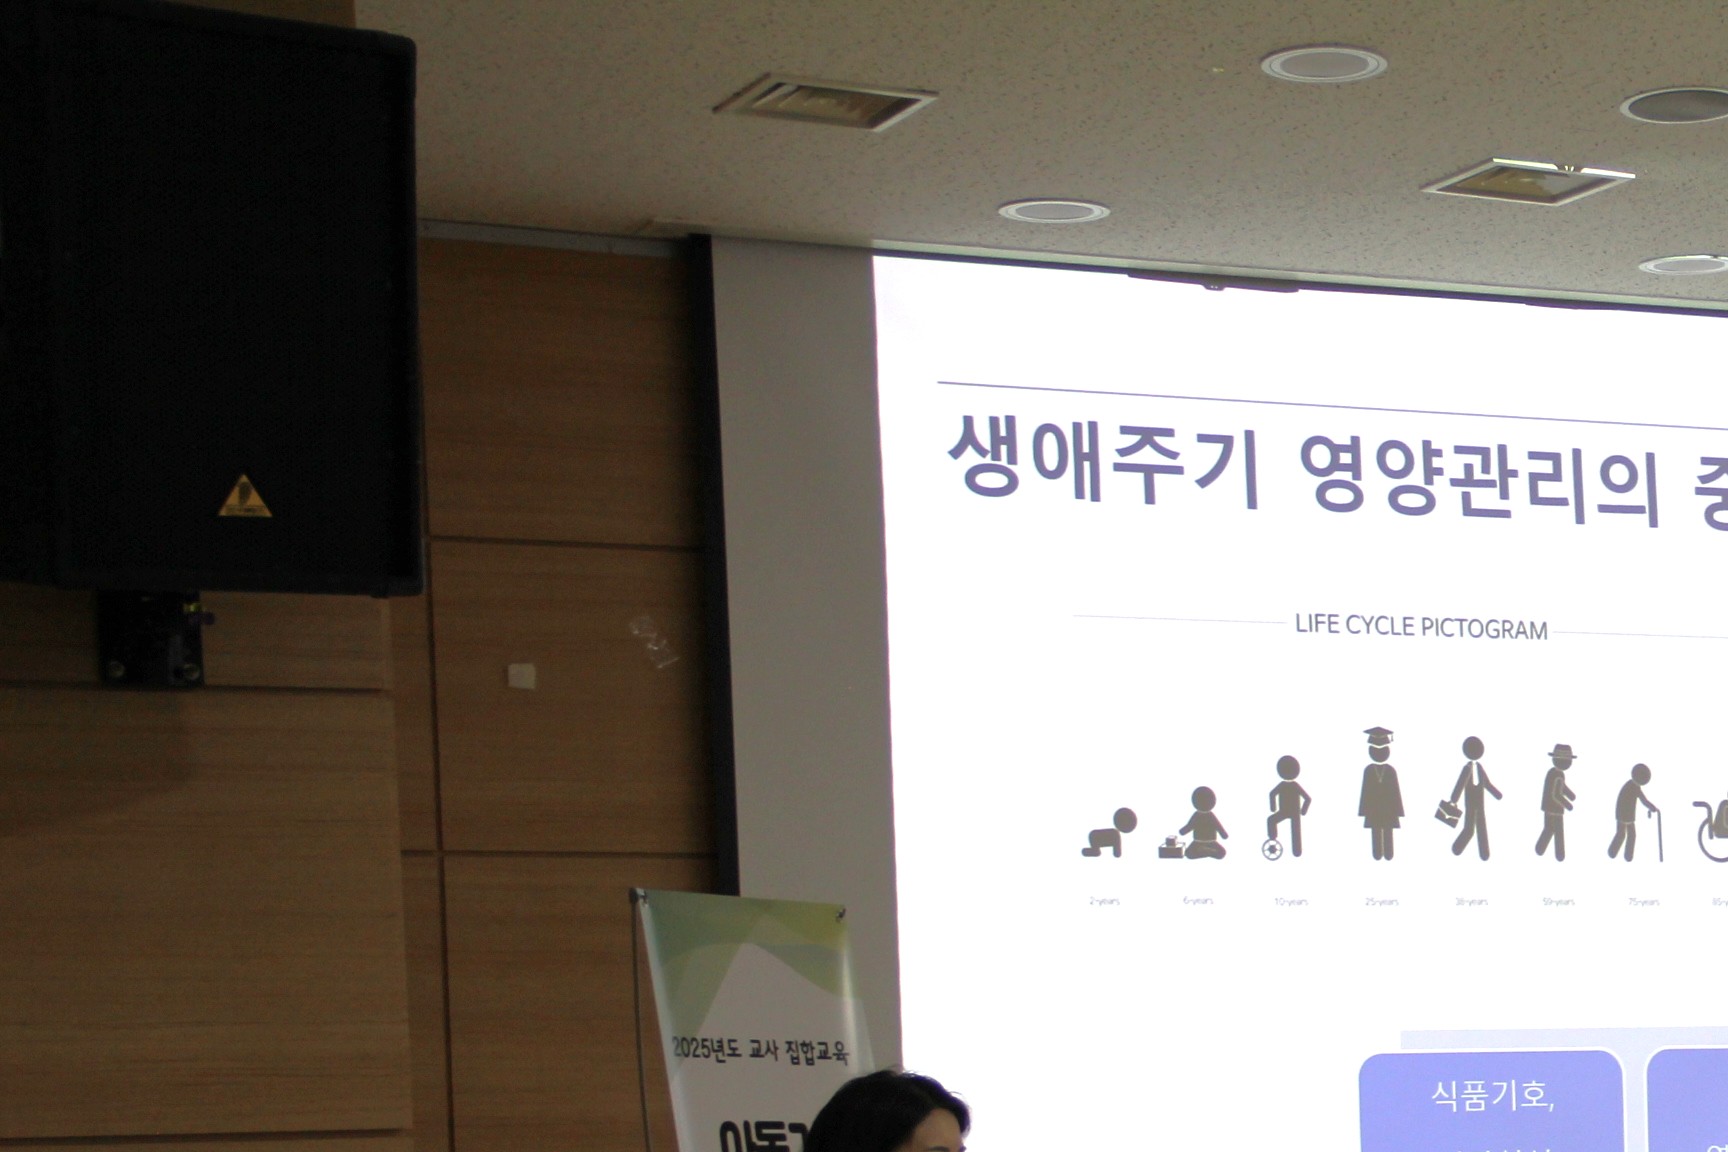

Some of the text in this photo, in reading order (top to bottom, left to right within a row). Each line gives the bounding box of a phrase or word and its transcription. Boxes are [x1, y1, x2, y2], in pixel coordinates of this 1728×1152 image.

[947, 415, 1257, 510] 생애주기
[1301, 435, 1658, 528] 영양관리의
[1295, 612, 1548, 641] LIFE CYCLE PICTOGRAM
[672, 1036, 849, 1066] 2025년도 교사 집합교육
[1431, 1079, 1555, 1113] 식품기호,
